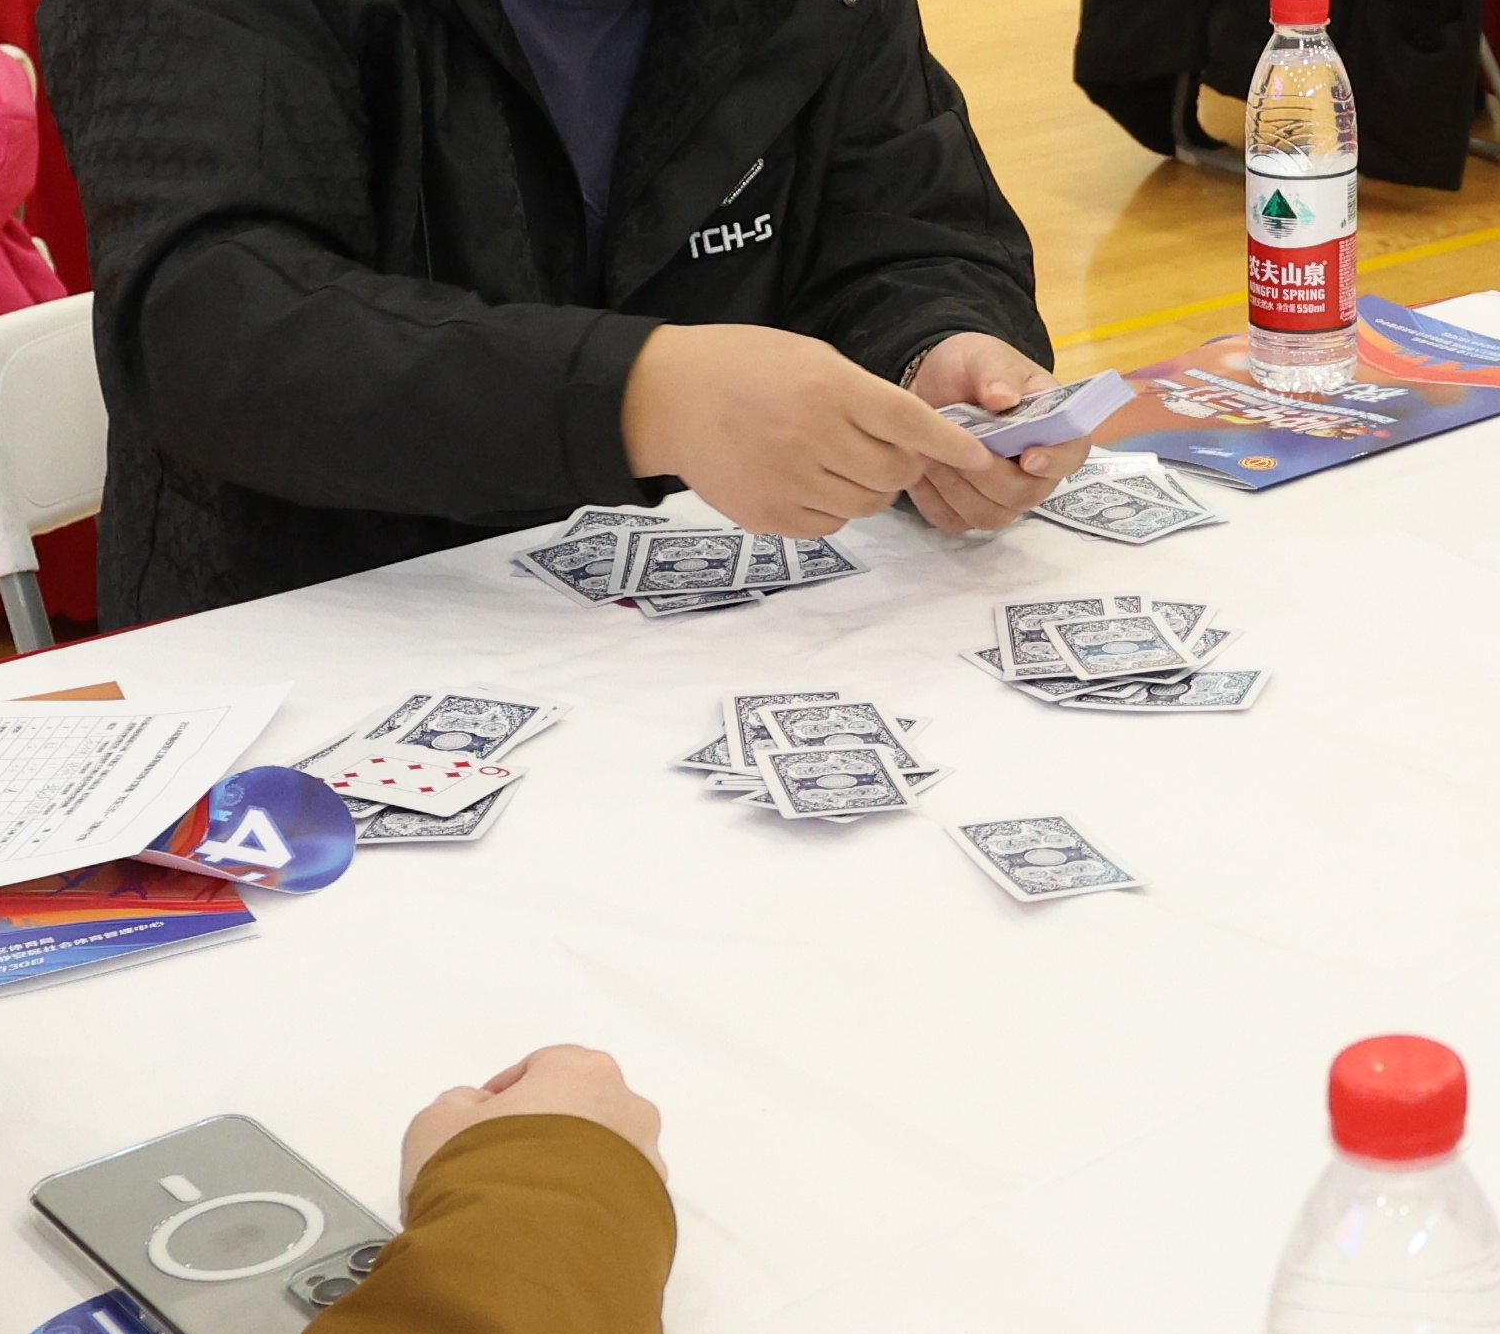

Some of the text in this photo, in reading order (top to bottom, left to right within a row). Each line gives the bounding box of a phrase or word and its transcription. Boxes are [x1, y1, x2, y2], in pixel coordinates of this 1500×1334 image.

[1249, 255, 1326, 286] 农夫山泉
[1282, 288, 1326, 302] SPRING
